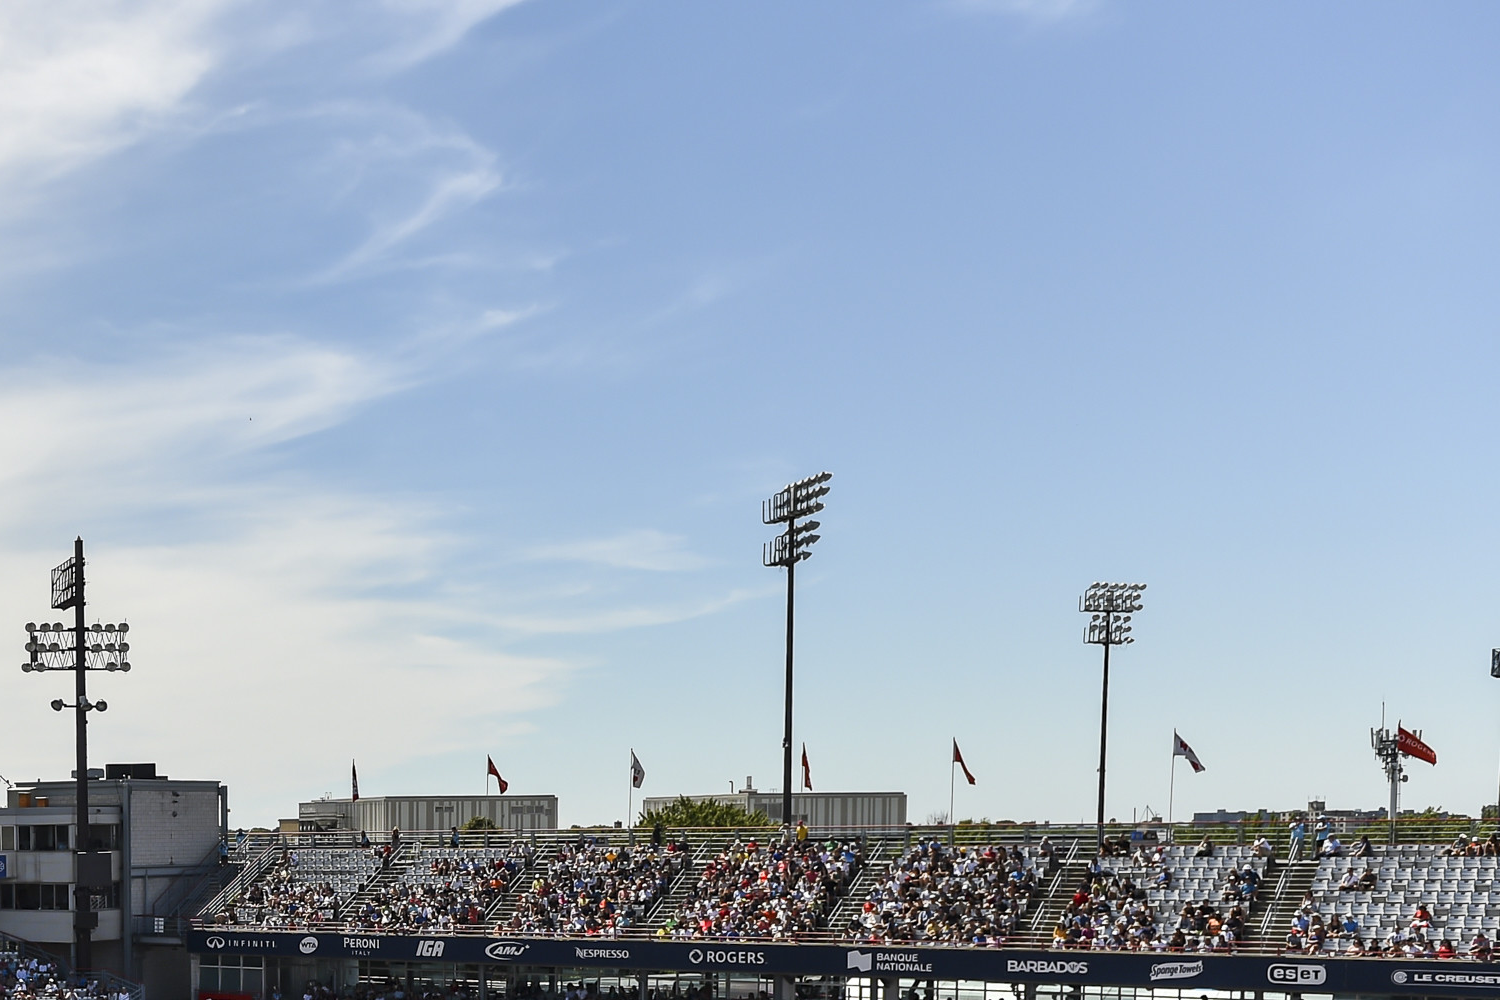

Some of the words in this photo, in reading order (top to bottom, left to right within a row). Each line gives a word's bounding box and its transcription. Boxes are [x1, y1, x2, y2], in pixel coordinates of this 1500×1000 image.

[228, 939, 276, 949] INFINITI
[301, 940, 316, 949] WTA
[343, 937, 380, 949] PERONI
[415, 940, 445, 957] IGA
[493, 946, 525, 956] AMJ
[574, 946, 630, 959] NESPRESSO
[706, 950, 765, 964] ROGERS
[876, 952, 919, 963] BANQUE
[876, 962, 932, 973] NATIONALE
[1007, 959, 1088, 974] BARBADOS
[1413, 973, 1433, 982] LE
